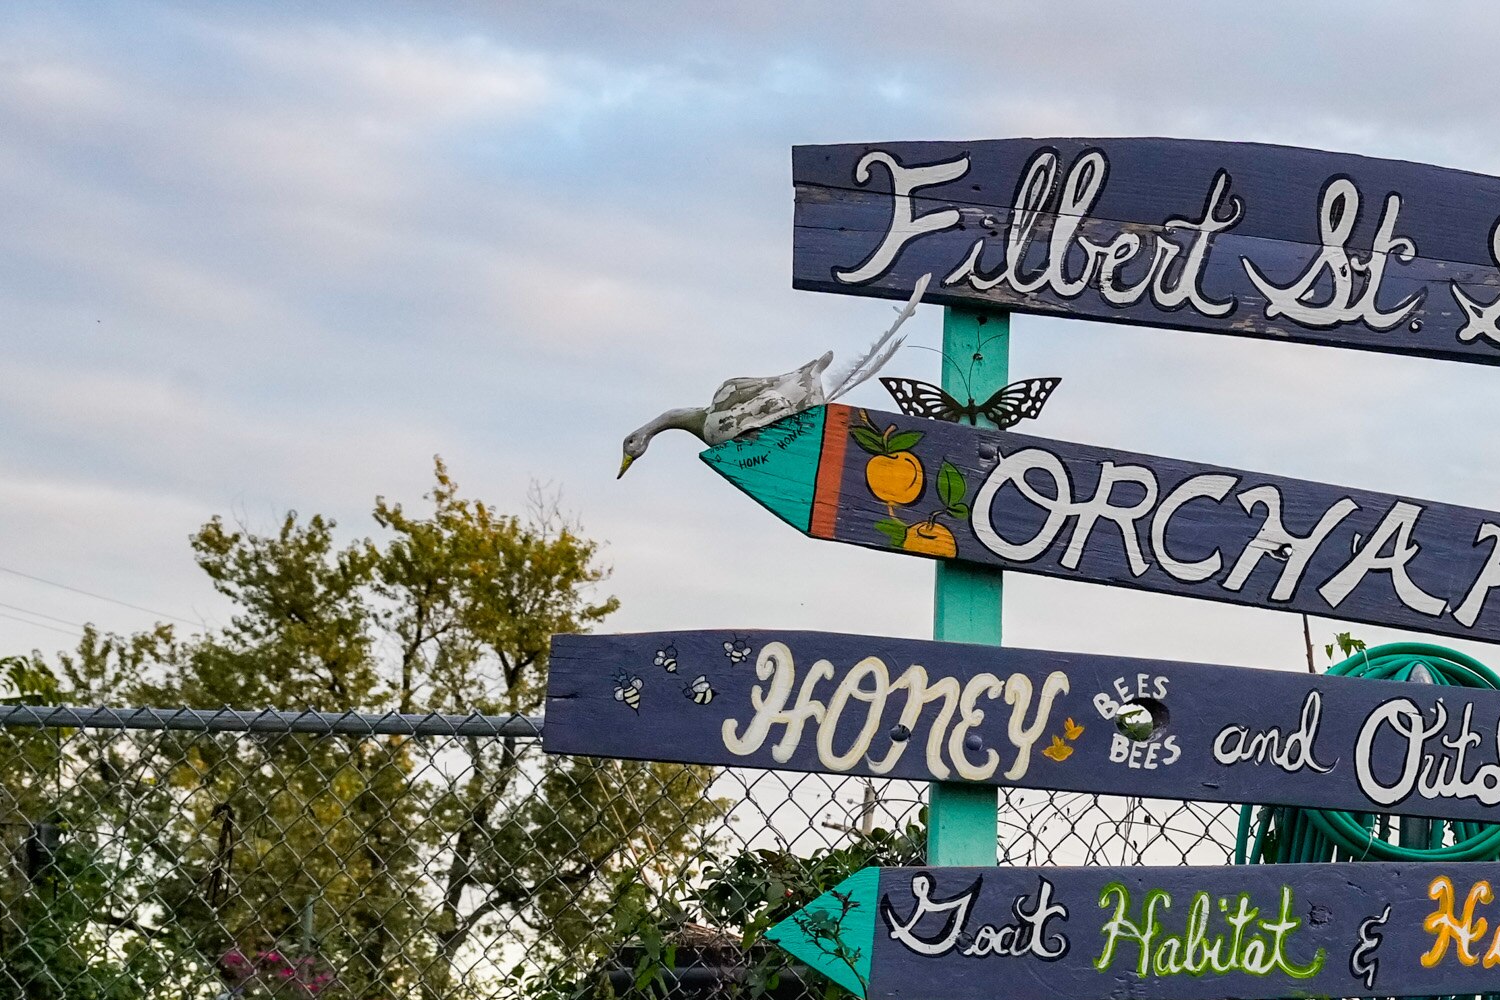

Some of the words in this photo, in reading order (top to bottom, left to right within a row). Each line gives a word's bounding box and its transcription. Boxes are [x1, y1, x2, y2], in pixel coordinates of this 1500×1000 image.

[832, 146, 1246, 318] Filbert
[1240, 174, 1428, 331] St.
[721, 641, 1070, 781] HONEY
[1211, 690, 1341, 773] and
[1093, 673, 1170, 720] BEES
[1109, 733, 1182, 770] BEES
[880, 870, 1070, 961] Goat
[1094, 881, 1326, 978] Habitat
[1349, 903, 1391, 990] &
